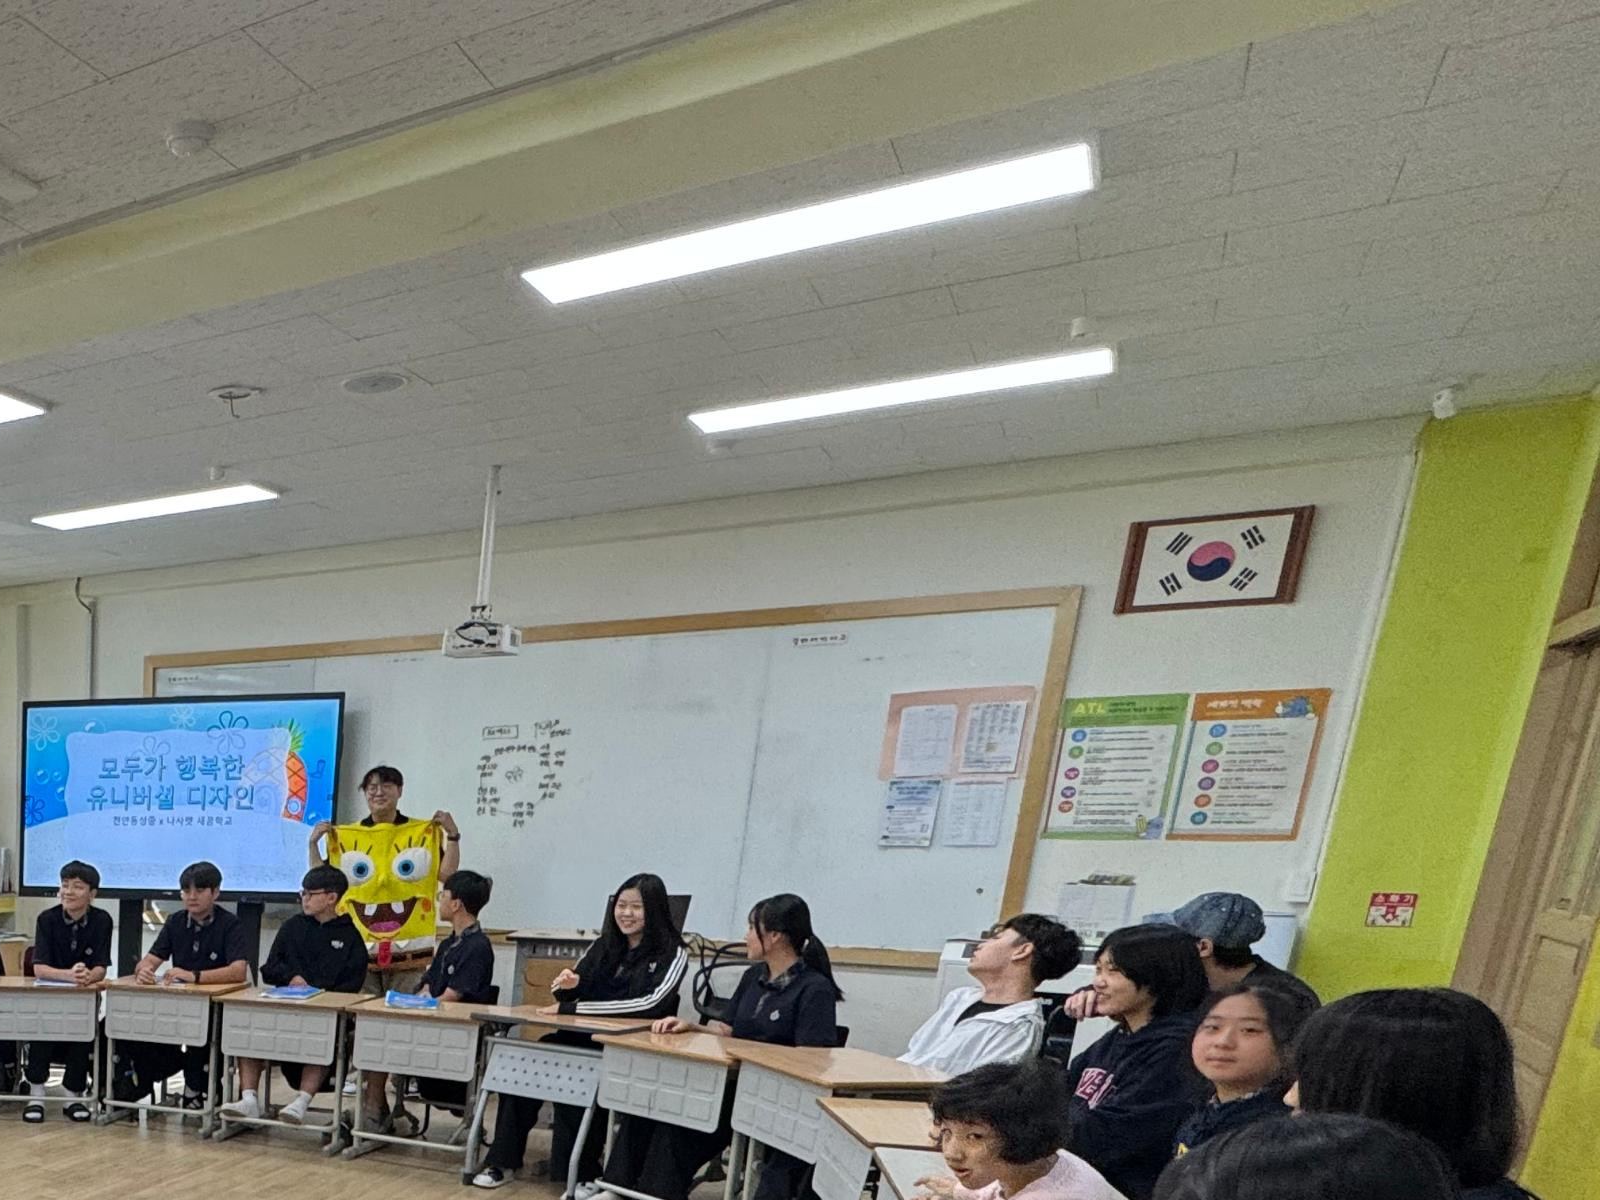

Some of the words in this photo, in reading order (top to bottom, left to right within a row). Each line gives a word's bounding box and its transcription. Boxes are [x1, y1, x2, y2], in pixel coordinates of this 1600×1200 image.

[98, 756, 167, 781] 모두가
[175, 754, 246, 781] 행복한
[187, 785, 255, 811] 디자인
